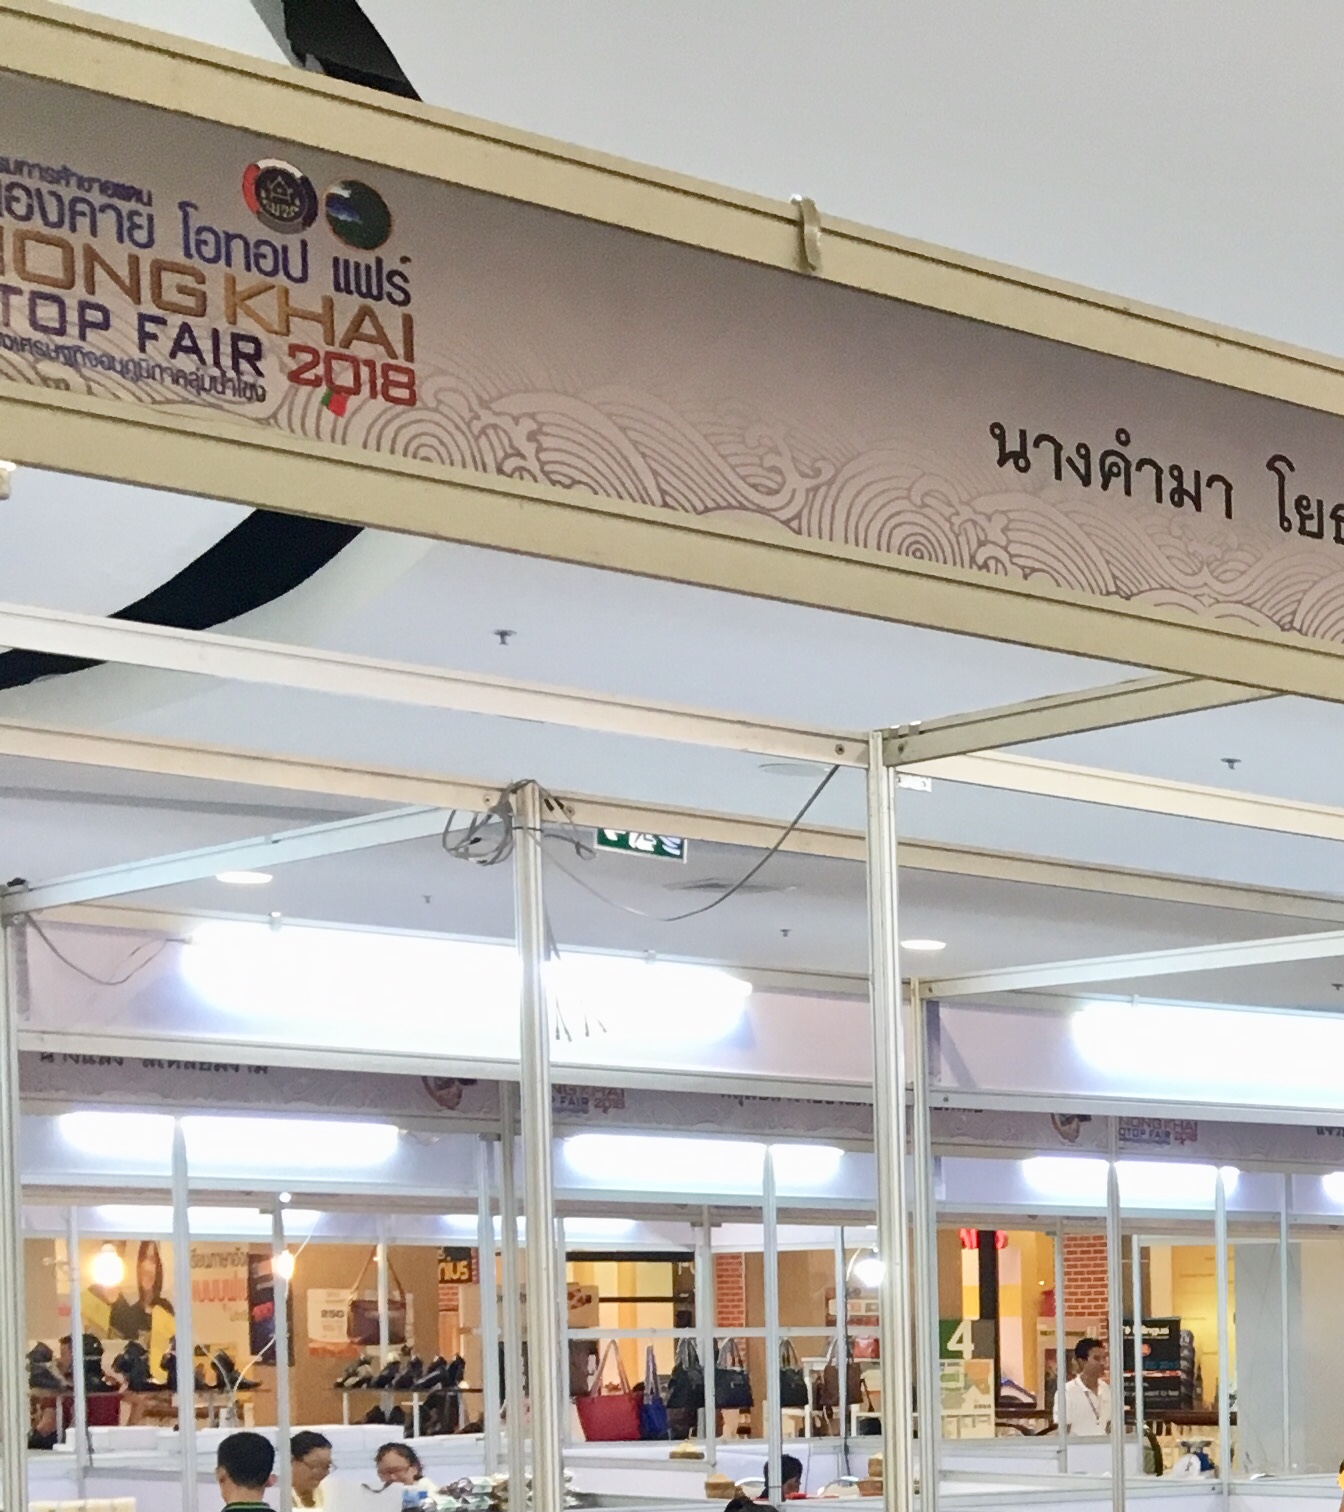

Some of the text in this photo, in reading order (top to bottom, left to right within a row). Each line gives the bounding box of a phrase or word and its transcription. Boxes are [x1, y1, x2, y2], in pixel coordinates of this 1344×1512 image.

[0, 179, 156, 249] องคาย
[178, 201, 310, 283] โอทอป
[332, 255, 413, 307] แฟร์
[0, 225, 415, 364] ONGKHAI
[0, 283, 417, 407] TOP FAIR 2018
[989, 421, 1234, 520] นางคำมา
[947, 1320, 975, 1360] 4
